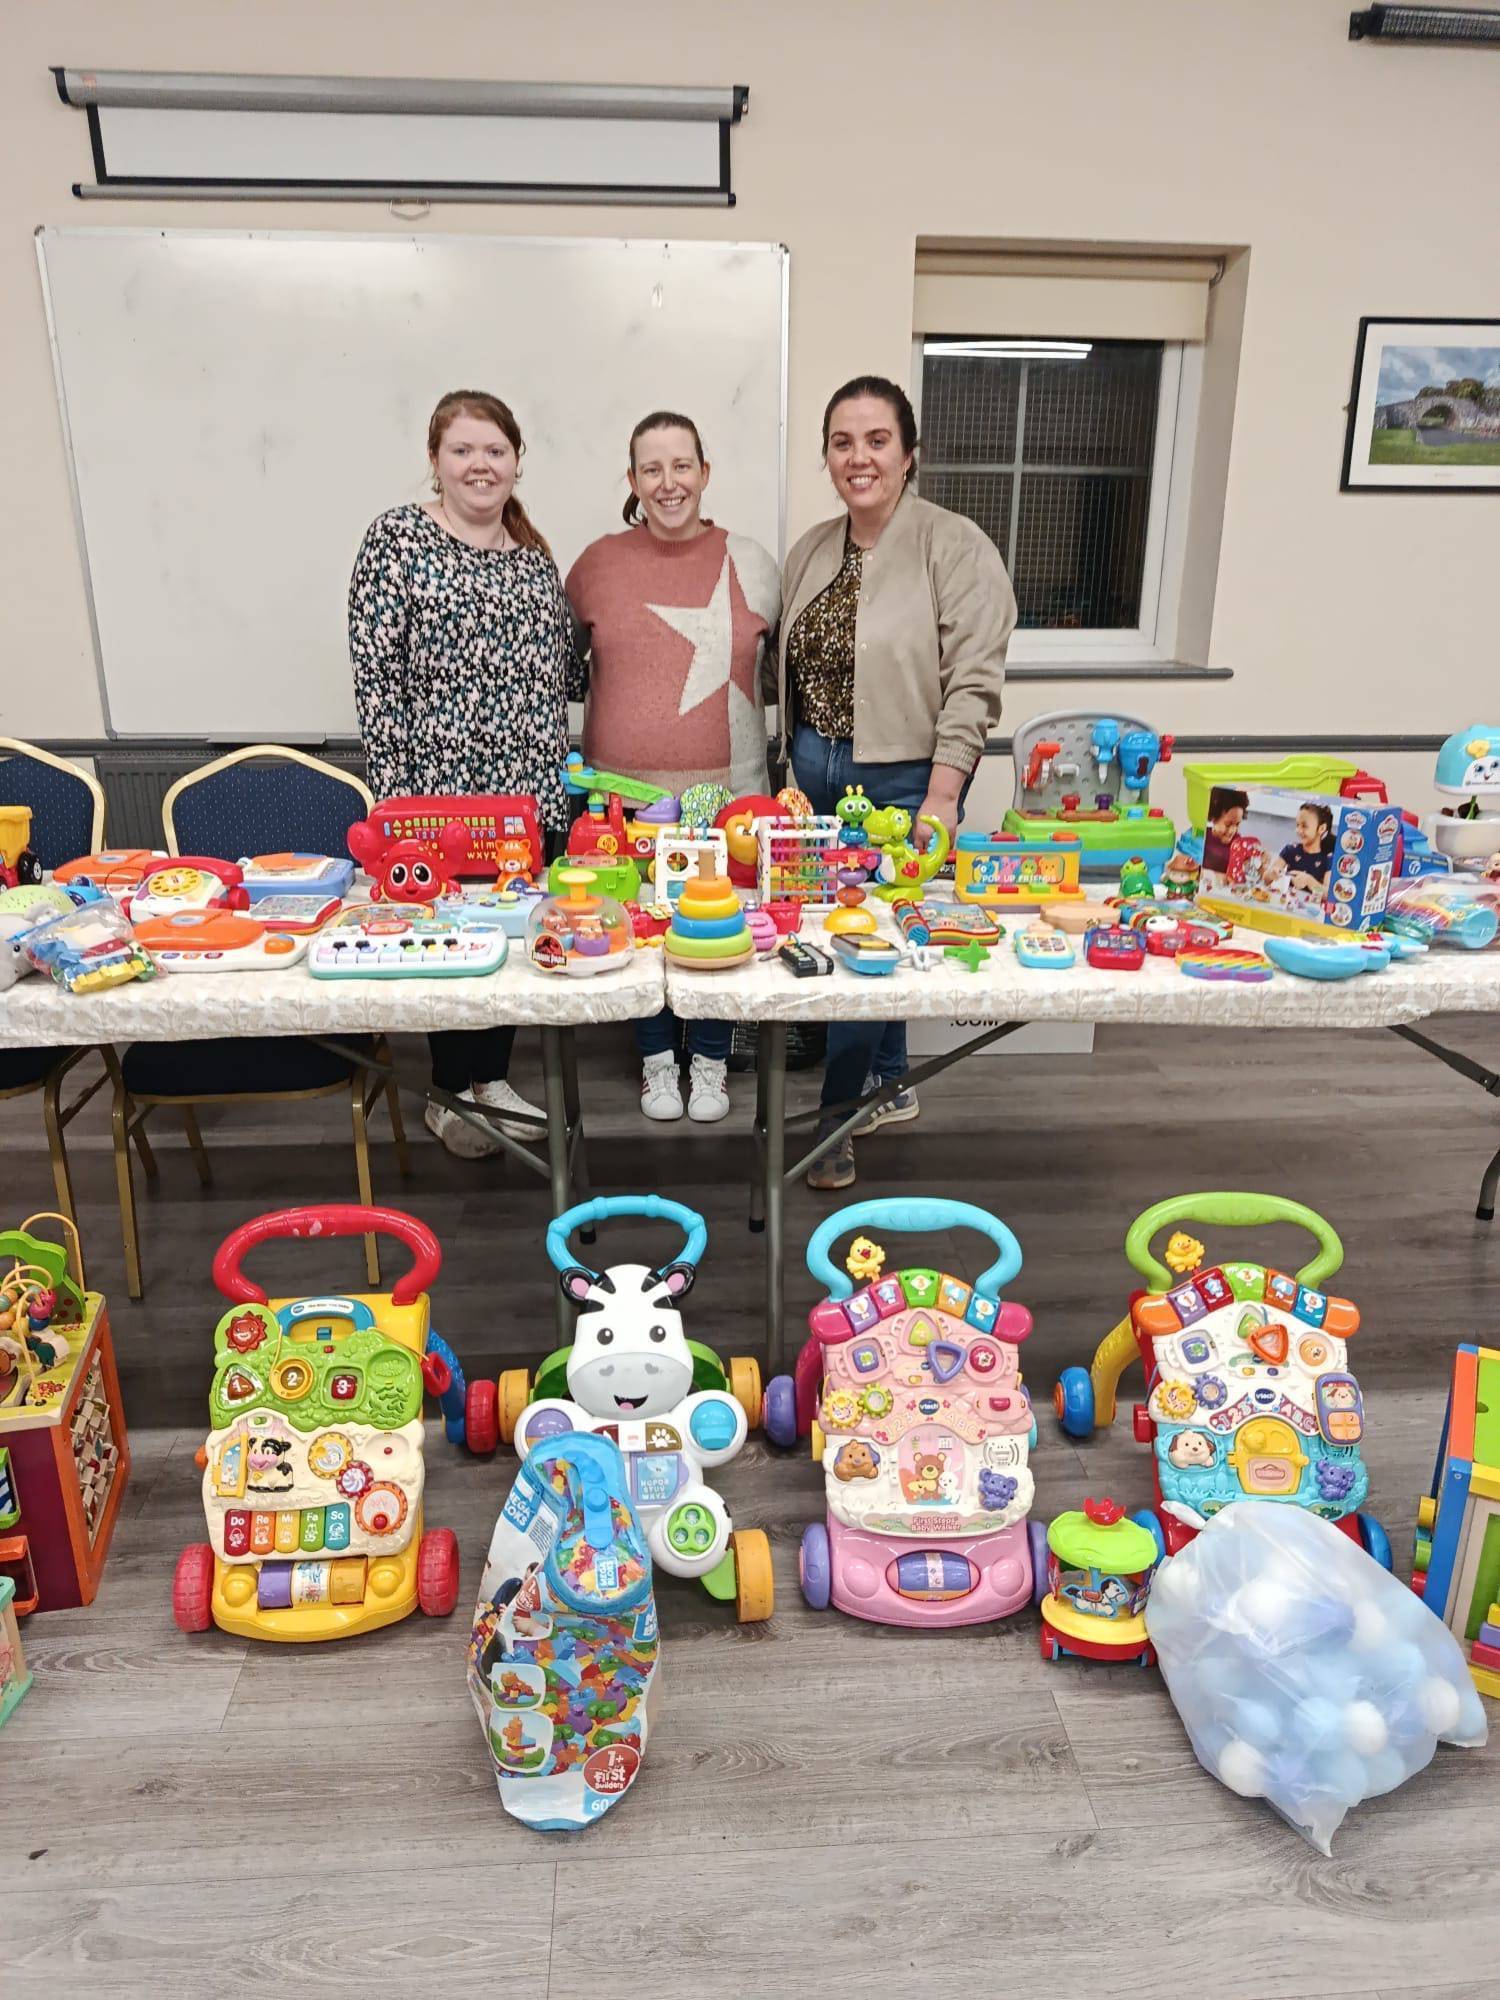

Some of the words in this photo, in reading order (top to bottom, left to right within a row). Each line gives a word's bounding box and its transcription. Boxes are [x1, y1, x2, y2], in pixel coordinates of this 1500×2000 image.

[287, 1372, 298, 1386] 2
[337, 1380, 348, 1394] 3
[230, 1516, 245, 1526] Do
[256, 1514, 269, 1524] Re
[306, 1512, 319, 1522] Fa
[330, 1510, 344, 1520] So
[594, 1765, 626, 1783] First
